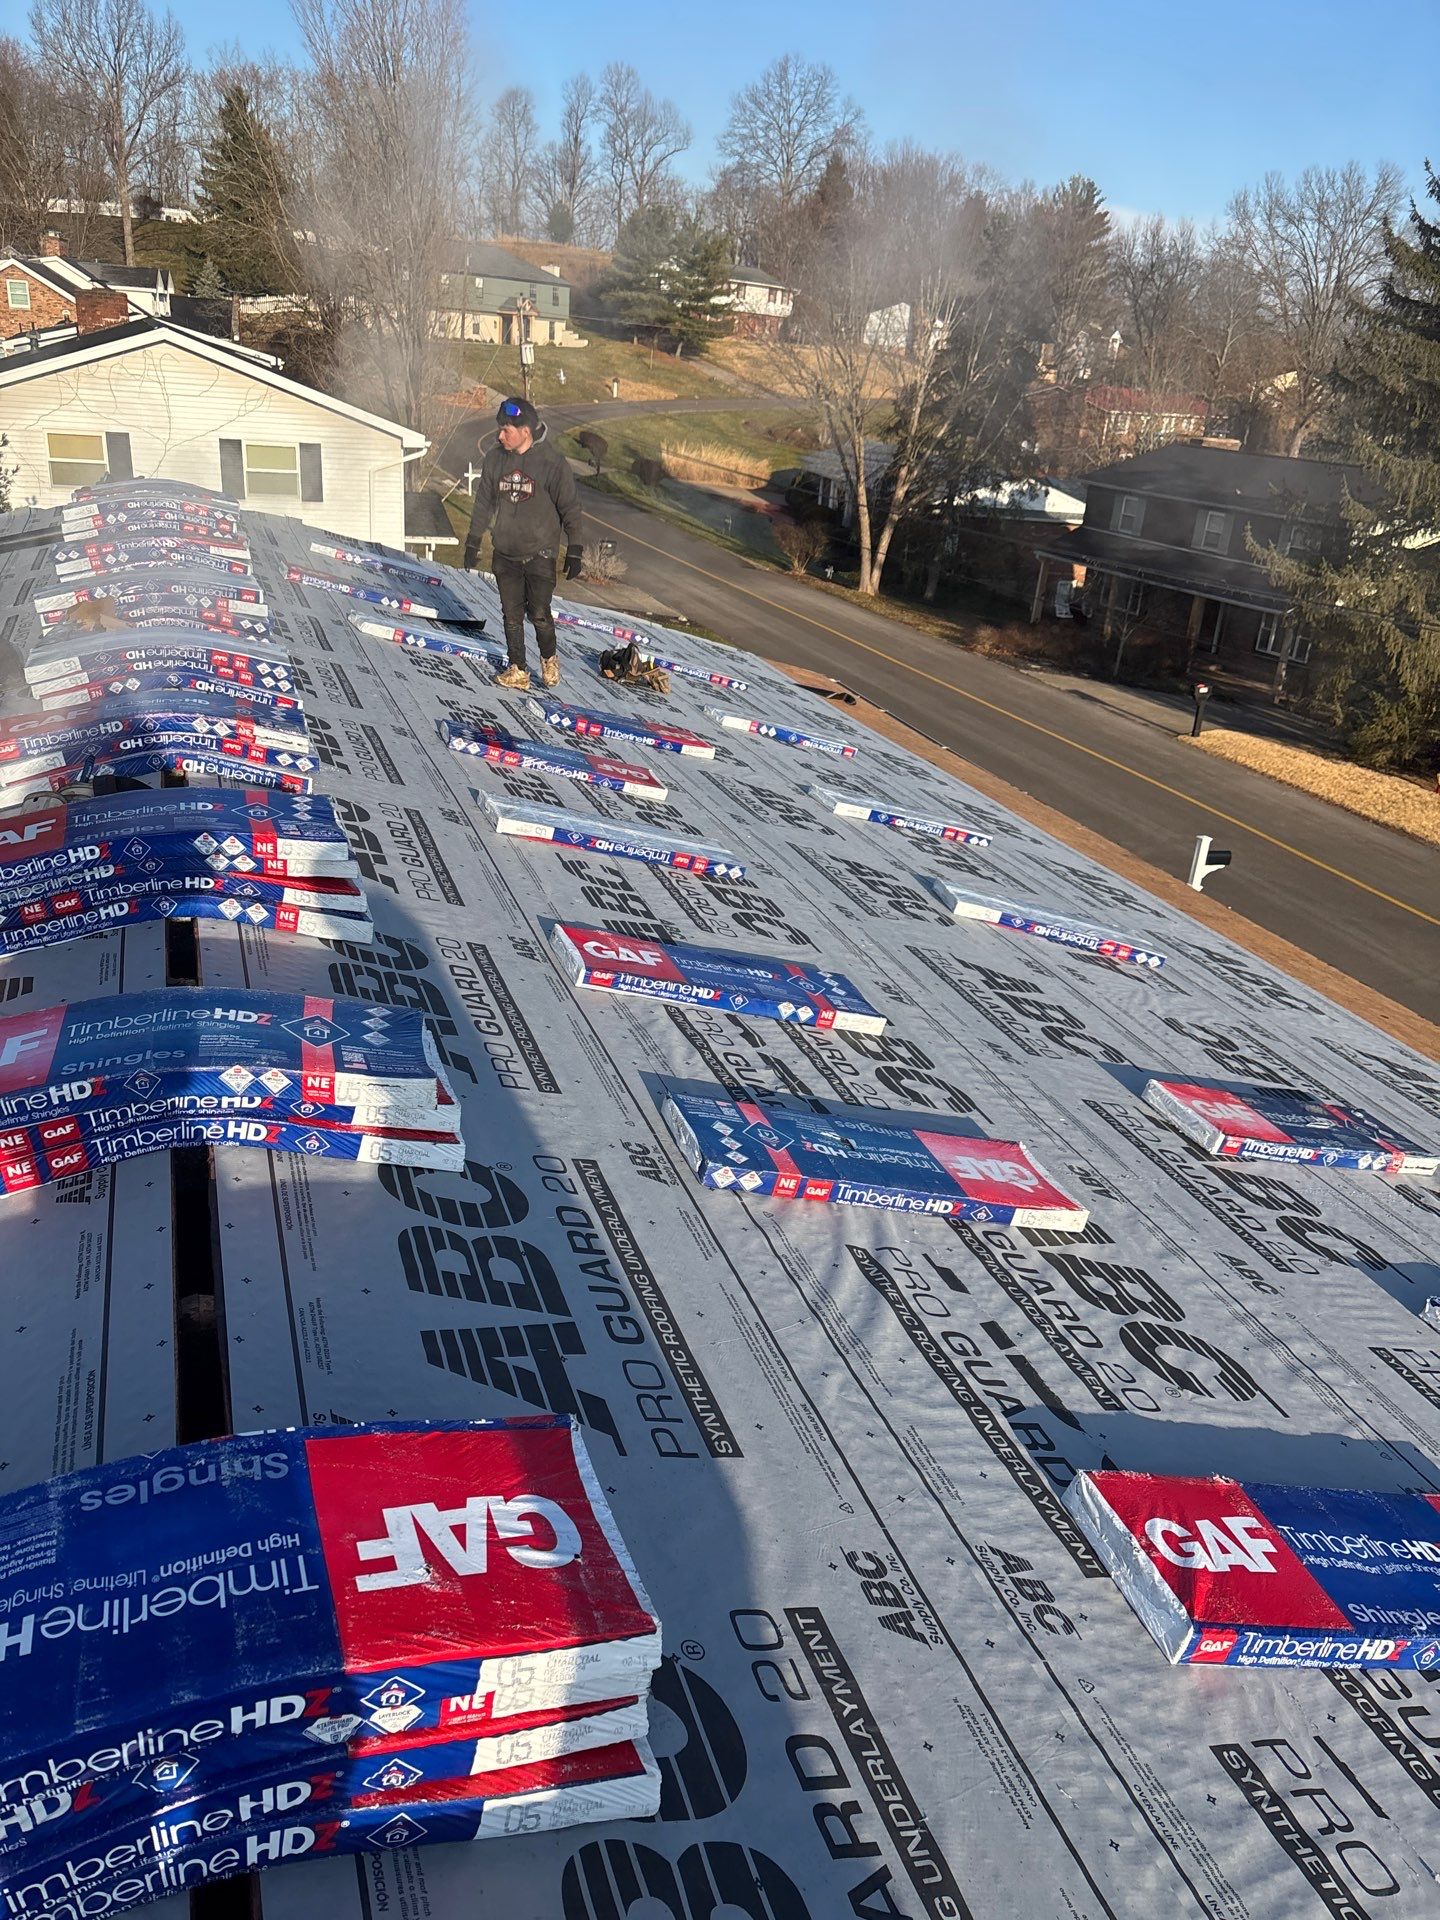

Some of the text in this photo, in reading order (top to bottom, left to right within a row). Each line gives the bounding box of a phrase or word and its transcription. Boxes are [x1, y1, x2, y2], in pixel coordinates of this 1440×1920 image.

[0, 818, 57, 846] AF
[256, 841, 275, 854] NE
[389, 822, 424, 868] GUARD
[267, 860, 284, 870] NE
[24, 903, 42, 915] NE
[54, 897, 78, 909] GAF
[280, 910, 296, 922] NE
[583, 940, 664, 968] GAF
[592, 971, 613, 981] GAF
[437, 937, 530, 1091] PRO GUARD 20
[820, 1009, 835, 1020] NE
[959, 979, 1031, 1034] GUARD
[68, 1033, 94, 1045] High
[686, 1008, 735, 1047] PRO
[61, 1049, 187, 1076] Shingles
[307, 1076, 331, 1090] NE
[1190, 1099, 1256, 1121] GAF
[43, 1123, 76, 1140] GAF
[6, 1160, 32, 1179] NE
[51, 1152, 83, 1170] GAF
[533, 1155, 580, 1196] 20
[620, 1138, 670, 1187] ABC
[950, 1154, 1040, 1193] GAF
[778, 1177, 797, 1190] NE
[806, 1187, 830, 1197] GAF
[1101, 1101, 1321, 1275] PRO GUARD 20
[579, 1160, 642, 1271] UNDERLAYMENT
[556, 1205, 646, 1345] GUARD
[875, 1246, 951, 1318] PRO
[1219, 1252, 1281, 1296] ABC
[635, 1273, 679, 1346] ROOFING
[982, 1231, 1162, 1413] GUARD 20
[1003, 1285, 1119, 1411] UNDERLAYMENT
[622, 1358, 699, 1459] PRO
[671, 1350, 733, 1453] SYNTHETIC
[853, 1248, 916, 1325] SYNTHETIC
[916, 1325, 973, 1403] ROOFING
[971, 1406, 1100, 1573] UNDERLAYMENT
[80, 1452, 289, 1512] Shingles
[257, 1533, 300, 1552] High
[356, 1494, 583, 1594] GAF
[1144, 1516, 1278, 1573] GAF
[1307, 1554, 1327, 1567] High
[902, 1575, 915, 1595] Co.
[975, 1544, 1008, 1587] Supply
[1004, 1588, 1020, 1608] Co.
[984, 1539, 1082, 1641] ABC
[839, 1546, 932, 1651] ABC
[1348, 1603, 1440, 1631] Shingle
[912, 1599, 944, 1645] Supply
[729, 1609, 811, 1703] 20
[1200, 1640, 1233, 1652] GAF
[1237, 1655, 1257, 1664] High
[449, 1693, 486, 1713] NE
[795, 1614, 944, 1886] UNDERLAYMENT
[1133, 1784, 1181, 1851] OVERLAP LINE
[1250, 1738, 1402, 1897] PRO
